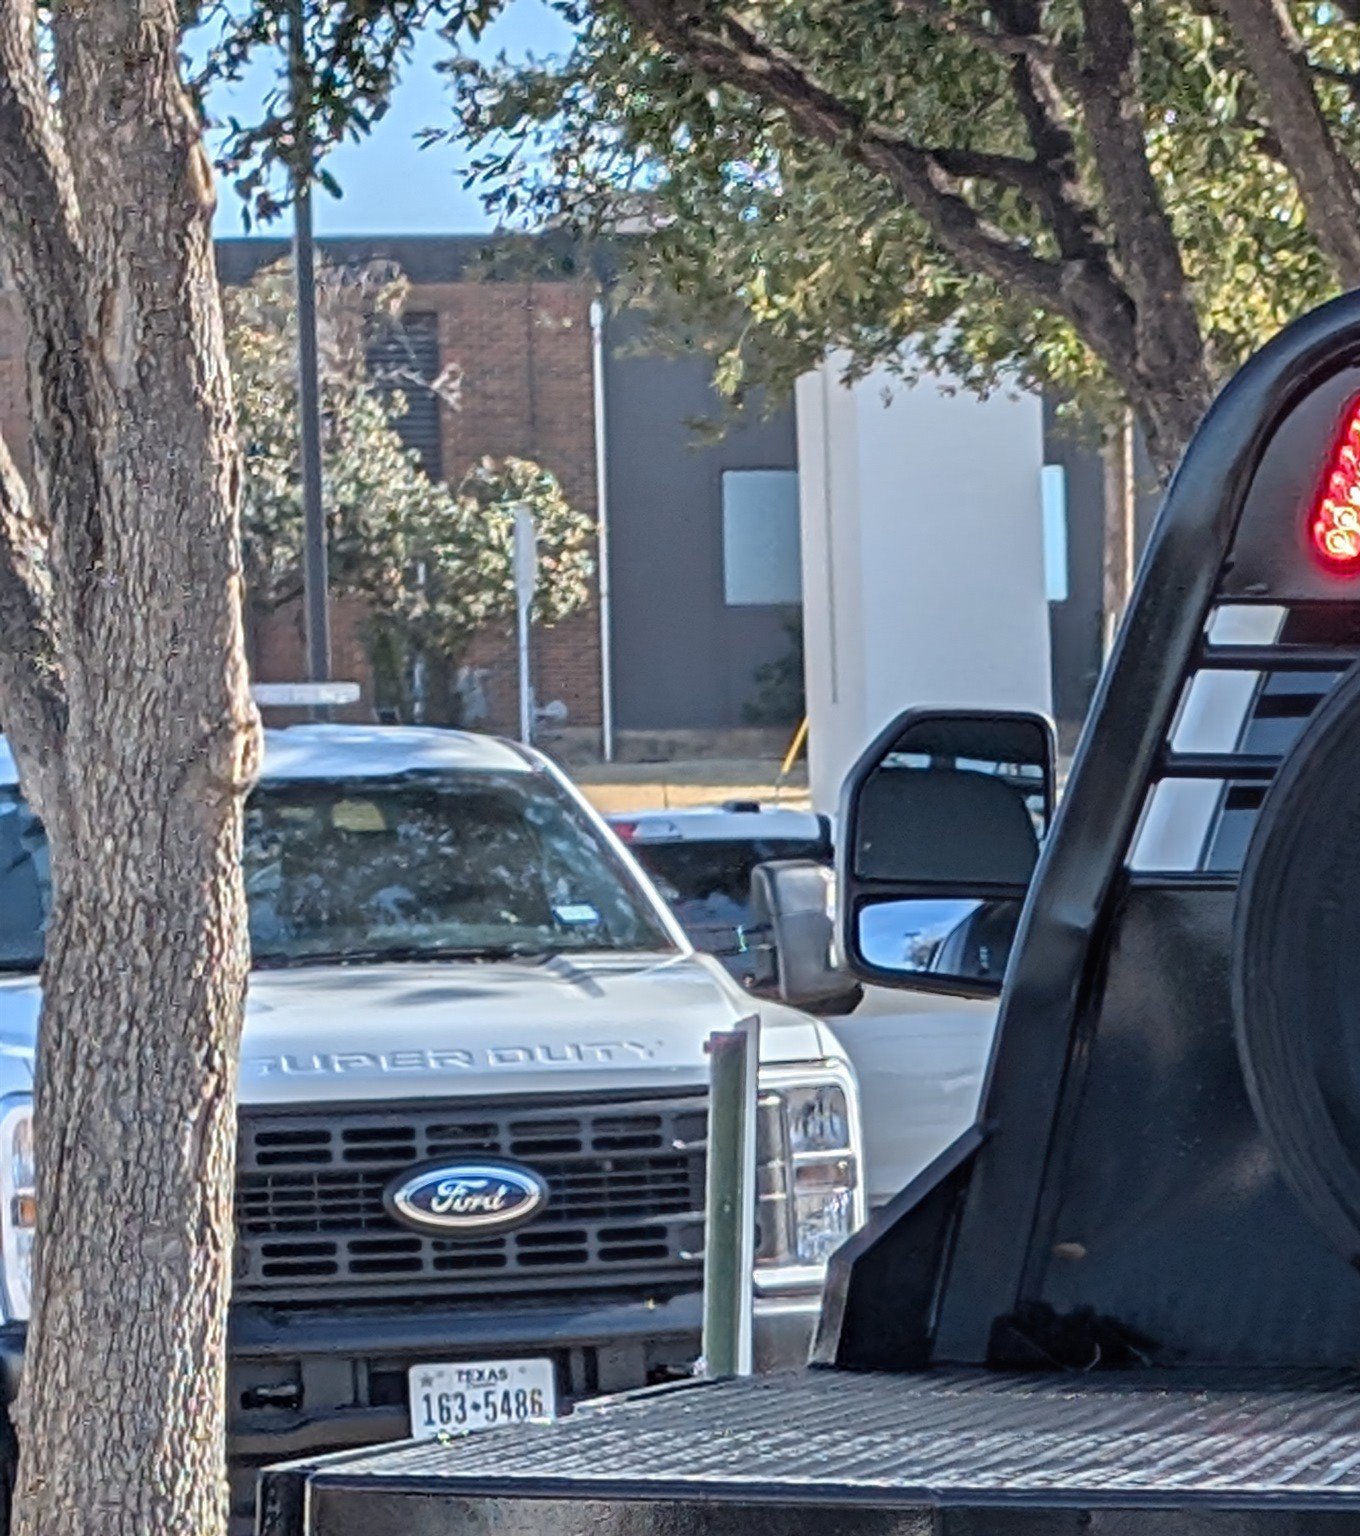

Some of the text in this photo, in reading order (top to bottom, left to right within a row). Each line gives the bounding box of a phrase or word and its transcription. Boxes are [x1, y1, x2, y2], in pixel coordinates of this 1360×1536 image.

[487, 1041, 666, 1067] DUTY
[431, 1179, 510, 1213] Ford
[456, 1367, 508, 1383] TEXAS
